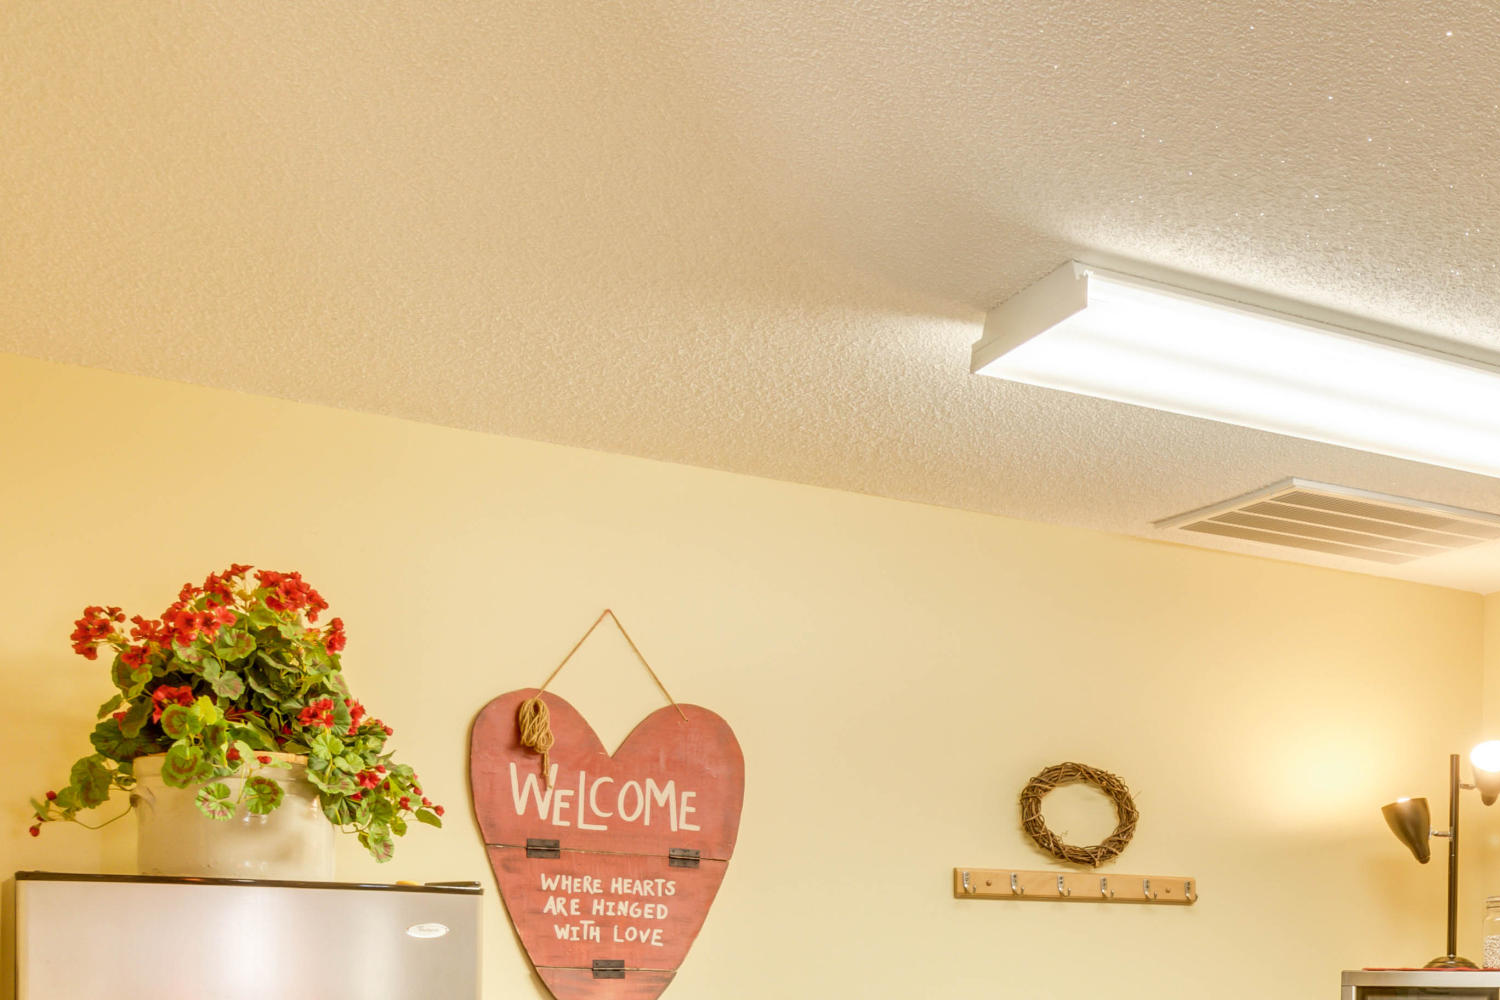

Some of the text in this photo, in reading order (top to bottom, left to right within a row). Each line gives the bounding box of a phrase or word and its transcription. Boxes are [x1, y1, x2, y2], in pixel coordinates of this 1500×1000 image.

[510, 762, 701, 832] WELCOME
[541, 873, 676, 897] WHERE HEARTS
[543, 896, 668, 920] ARE HINGED
[554, 920, 664, 947] WITH LOVE
